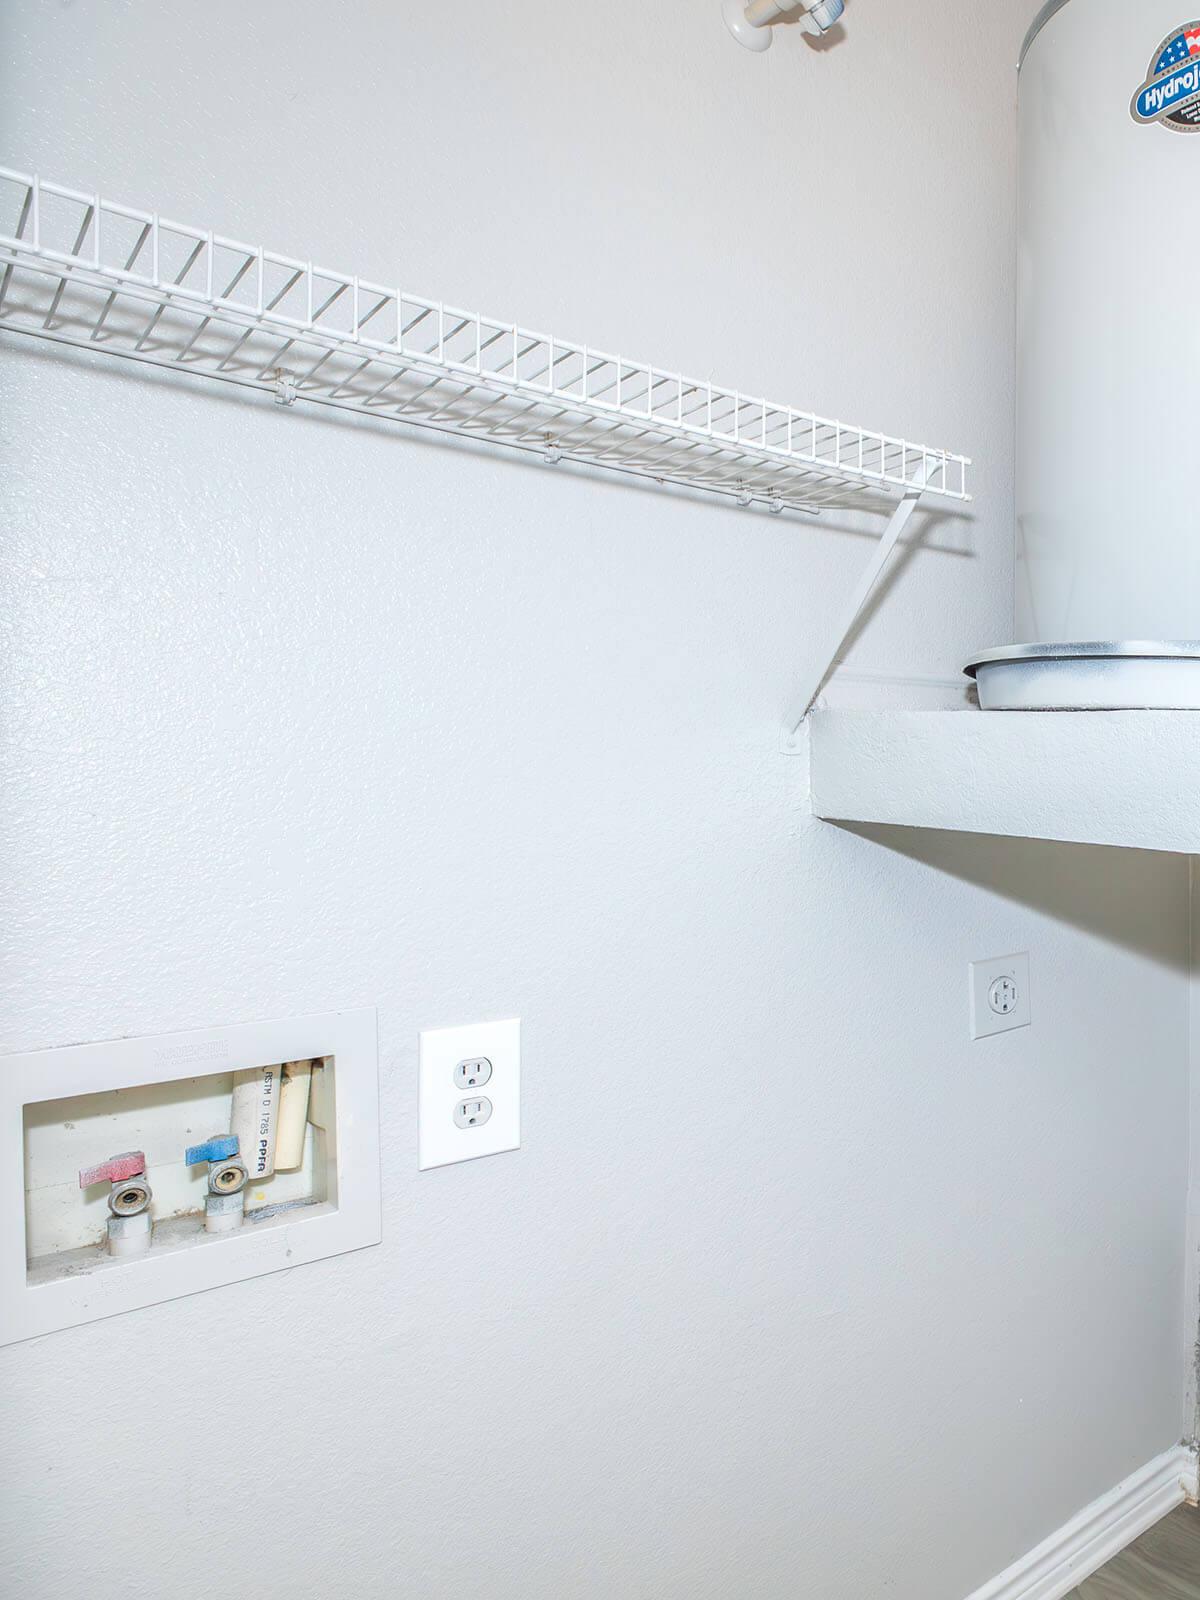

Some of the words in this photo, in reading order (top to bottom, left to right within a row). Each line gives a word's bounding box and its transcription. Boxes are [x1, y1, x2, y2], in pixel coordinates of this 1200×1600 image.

[264, 1071, 273, 1095] ASTM
[260, 1112, 270, 1135] 1785
[258, 1139, 268, 1172] PPFA
